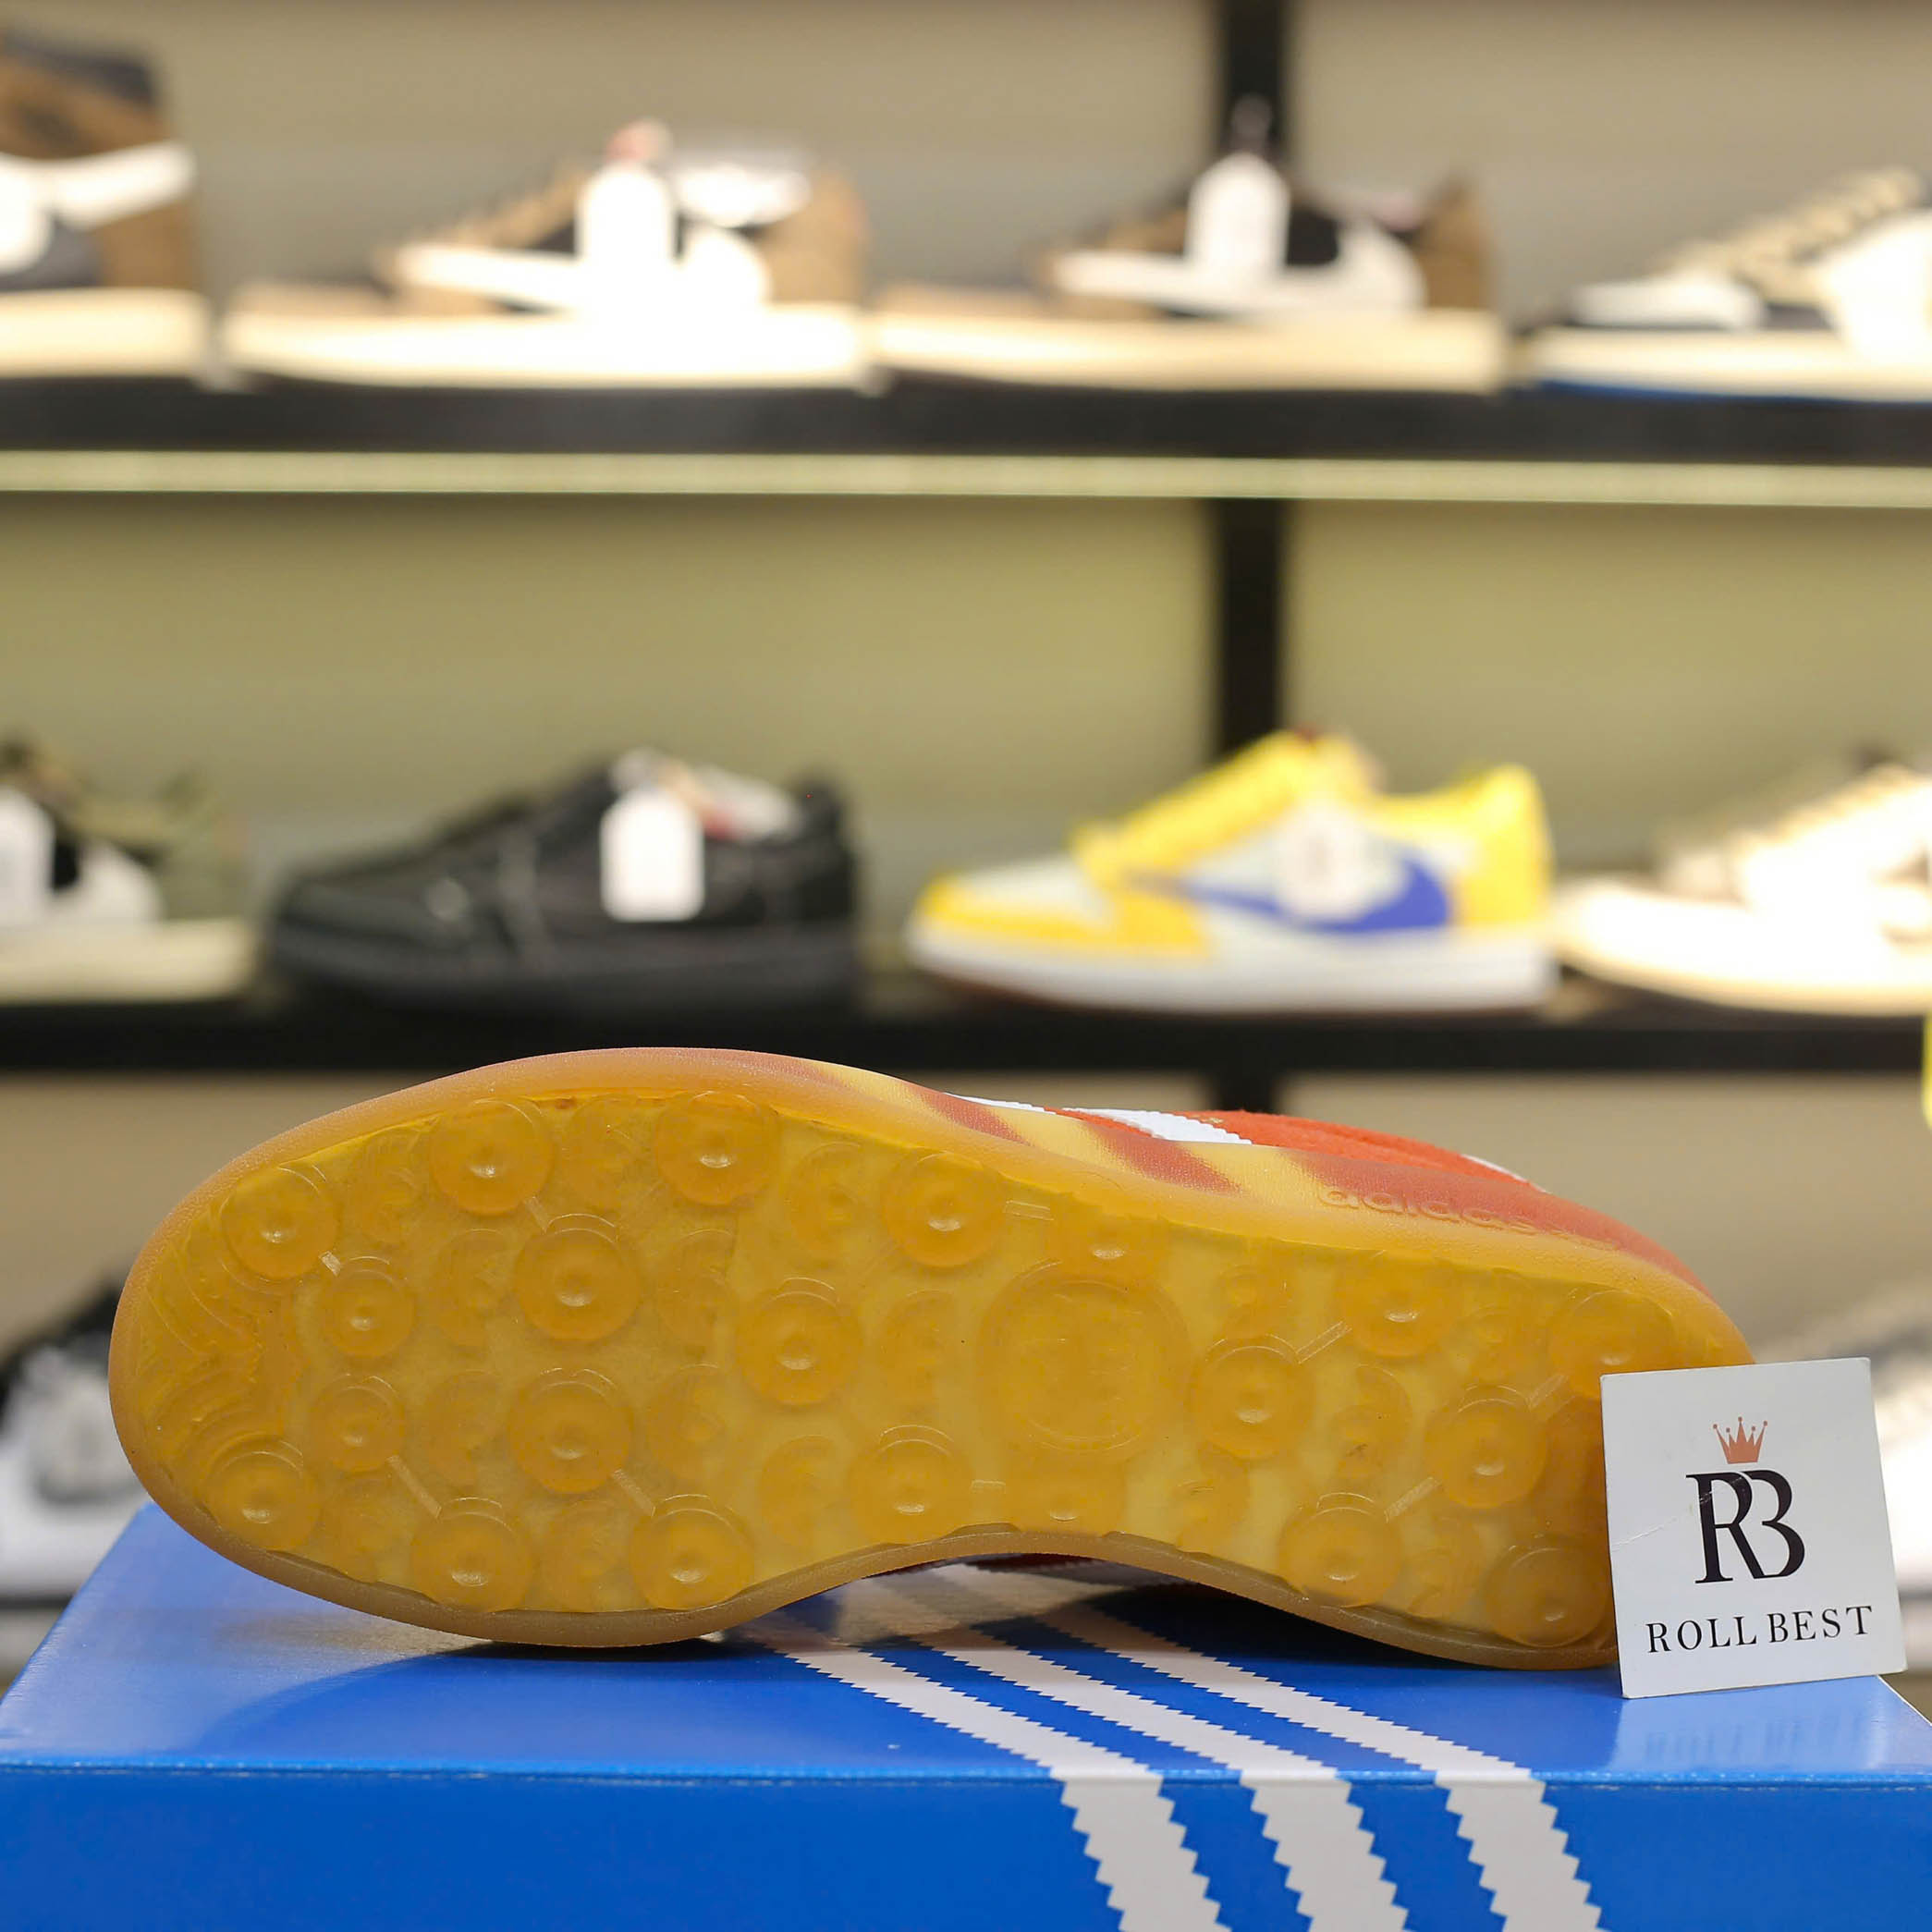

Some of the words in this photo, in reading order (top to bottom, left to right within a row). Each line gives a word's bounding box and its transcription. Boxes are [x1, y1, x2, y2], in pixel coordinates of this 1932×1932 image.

[1318, 1184, 1538, 1236] adidas
[1685, 1469, 1805, 1584] RB
[1645, 1616, 1757, 1653] ROLL
[1767, 1606, 1872, 1643] BEST
